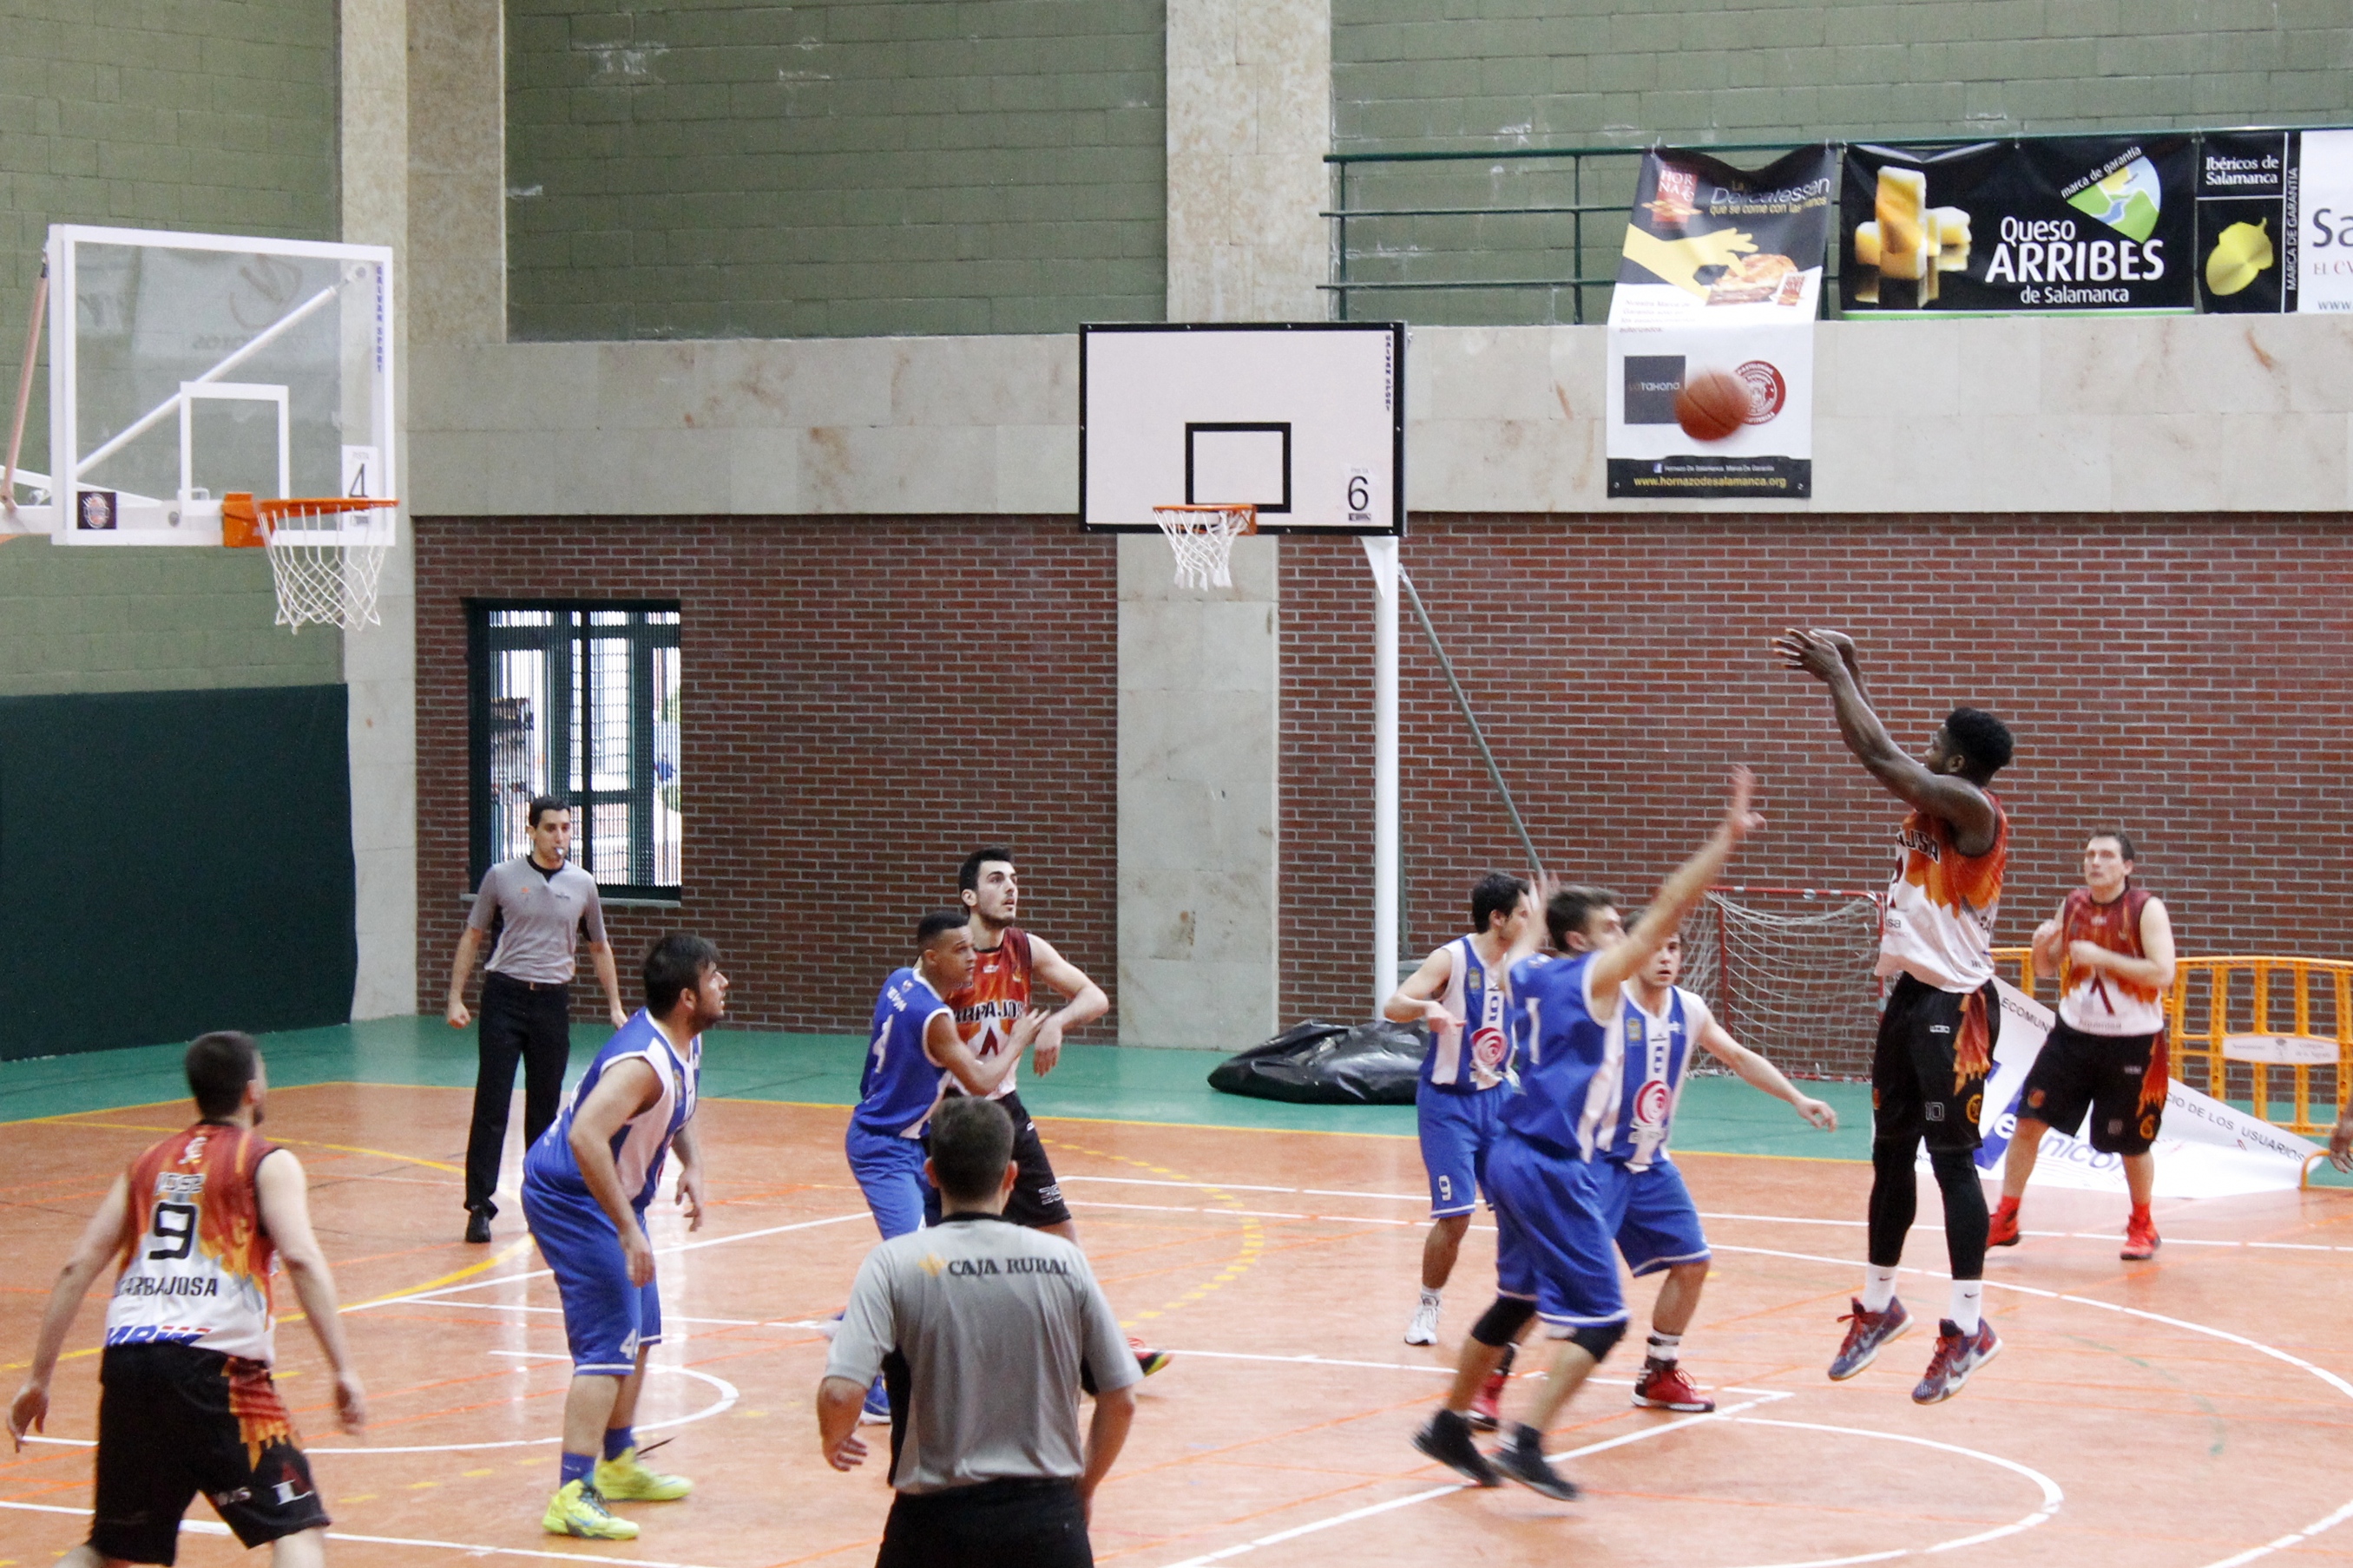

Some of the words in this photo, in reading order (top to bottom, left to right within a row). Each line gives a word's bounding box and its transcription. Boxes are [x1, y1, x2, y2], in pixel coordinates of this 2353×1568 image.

[2205, 156, 2258, 171] Ibéricos
[2261, 154, 2279, 169] de
[2061, 176, 2090, 199] marca
[2089, 168, 2103, 181] de
[2205, 171, 2278, 186] Salamanca
[2000, 216, 2076, 247] Queso
[2286, 228, 2297, 246] DE
[1984, 239, 2166, 284] ARRIBES
[2286, 246, 2297, 291] MARCA
[2020, 285, 2041, 304] de
[2044, 285, 2130, 304] Salamanca
[1348, 476, 1369, 511] 6
[2188, 1103, 2206, 1118] DE
[2208, 1112, 2234, 1131] LOS
[2241, 1126, 2306, 1163] USUARIOS
[1438, 1174, 1452, 1202] 9
[148, 1201, 198, 1260] 9
[948, 1257, 999, 1277] CAJA
[1007, 1256, 1069, 1276] RURAL
